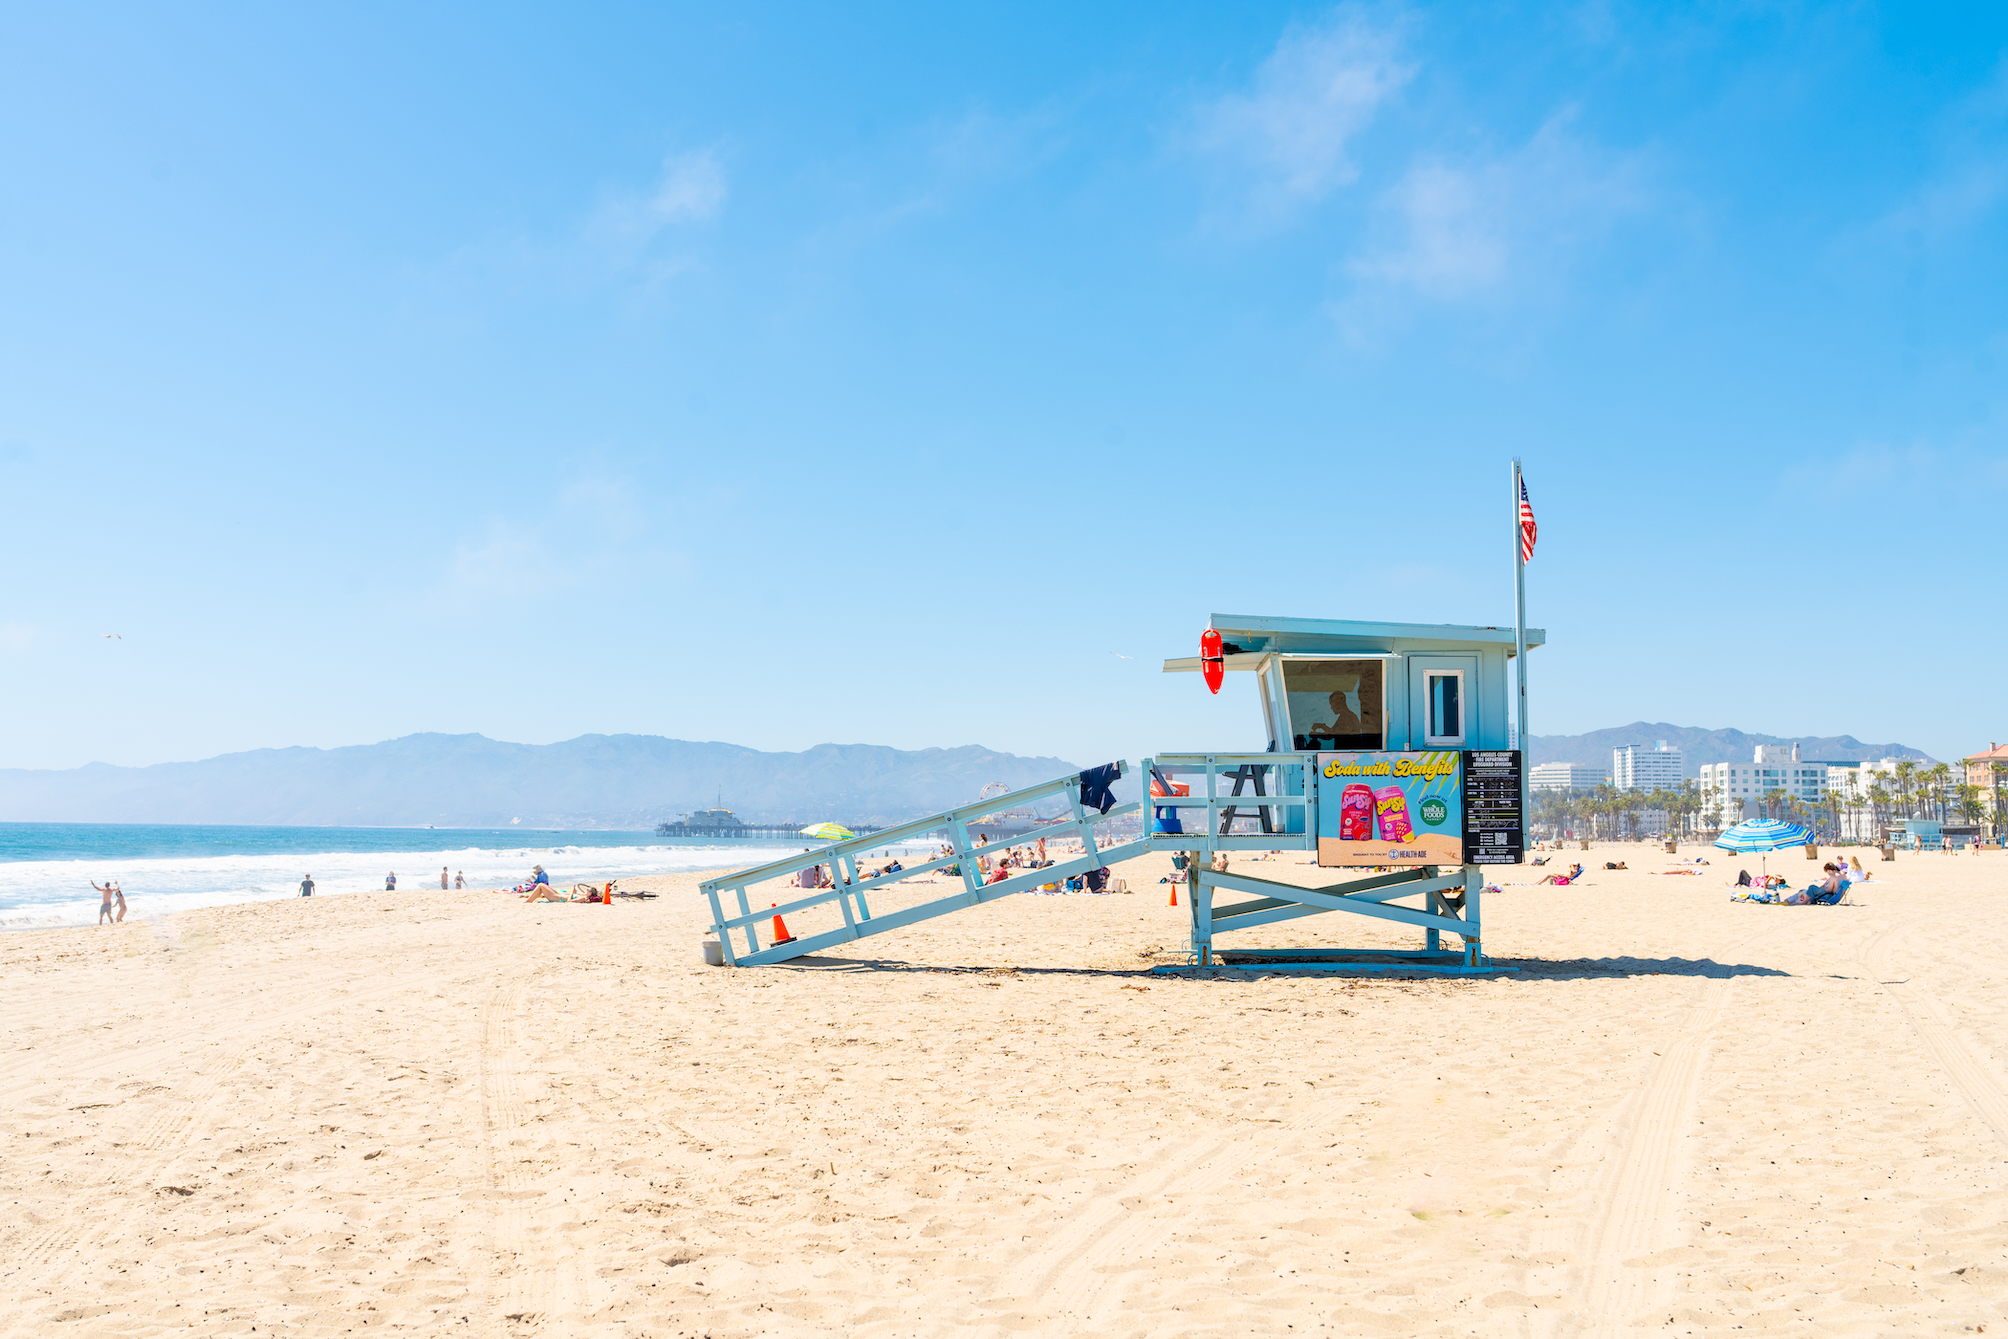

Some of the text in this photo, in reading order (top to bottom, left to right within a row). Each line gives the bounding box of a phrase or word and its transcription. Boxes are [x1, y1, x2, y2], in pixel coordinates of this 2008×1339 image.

[1324, 758, 1454, 782] Soda with Benefits
